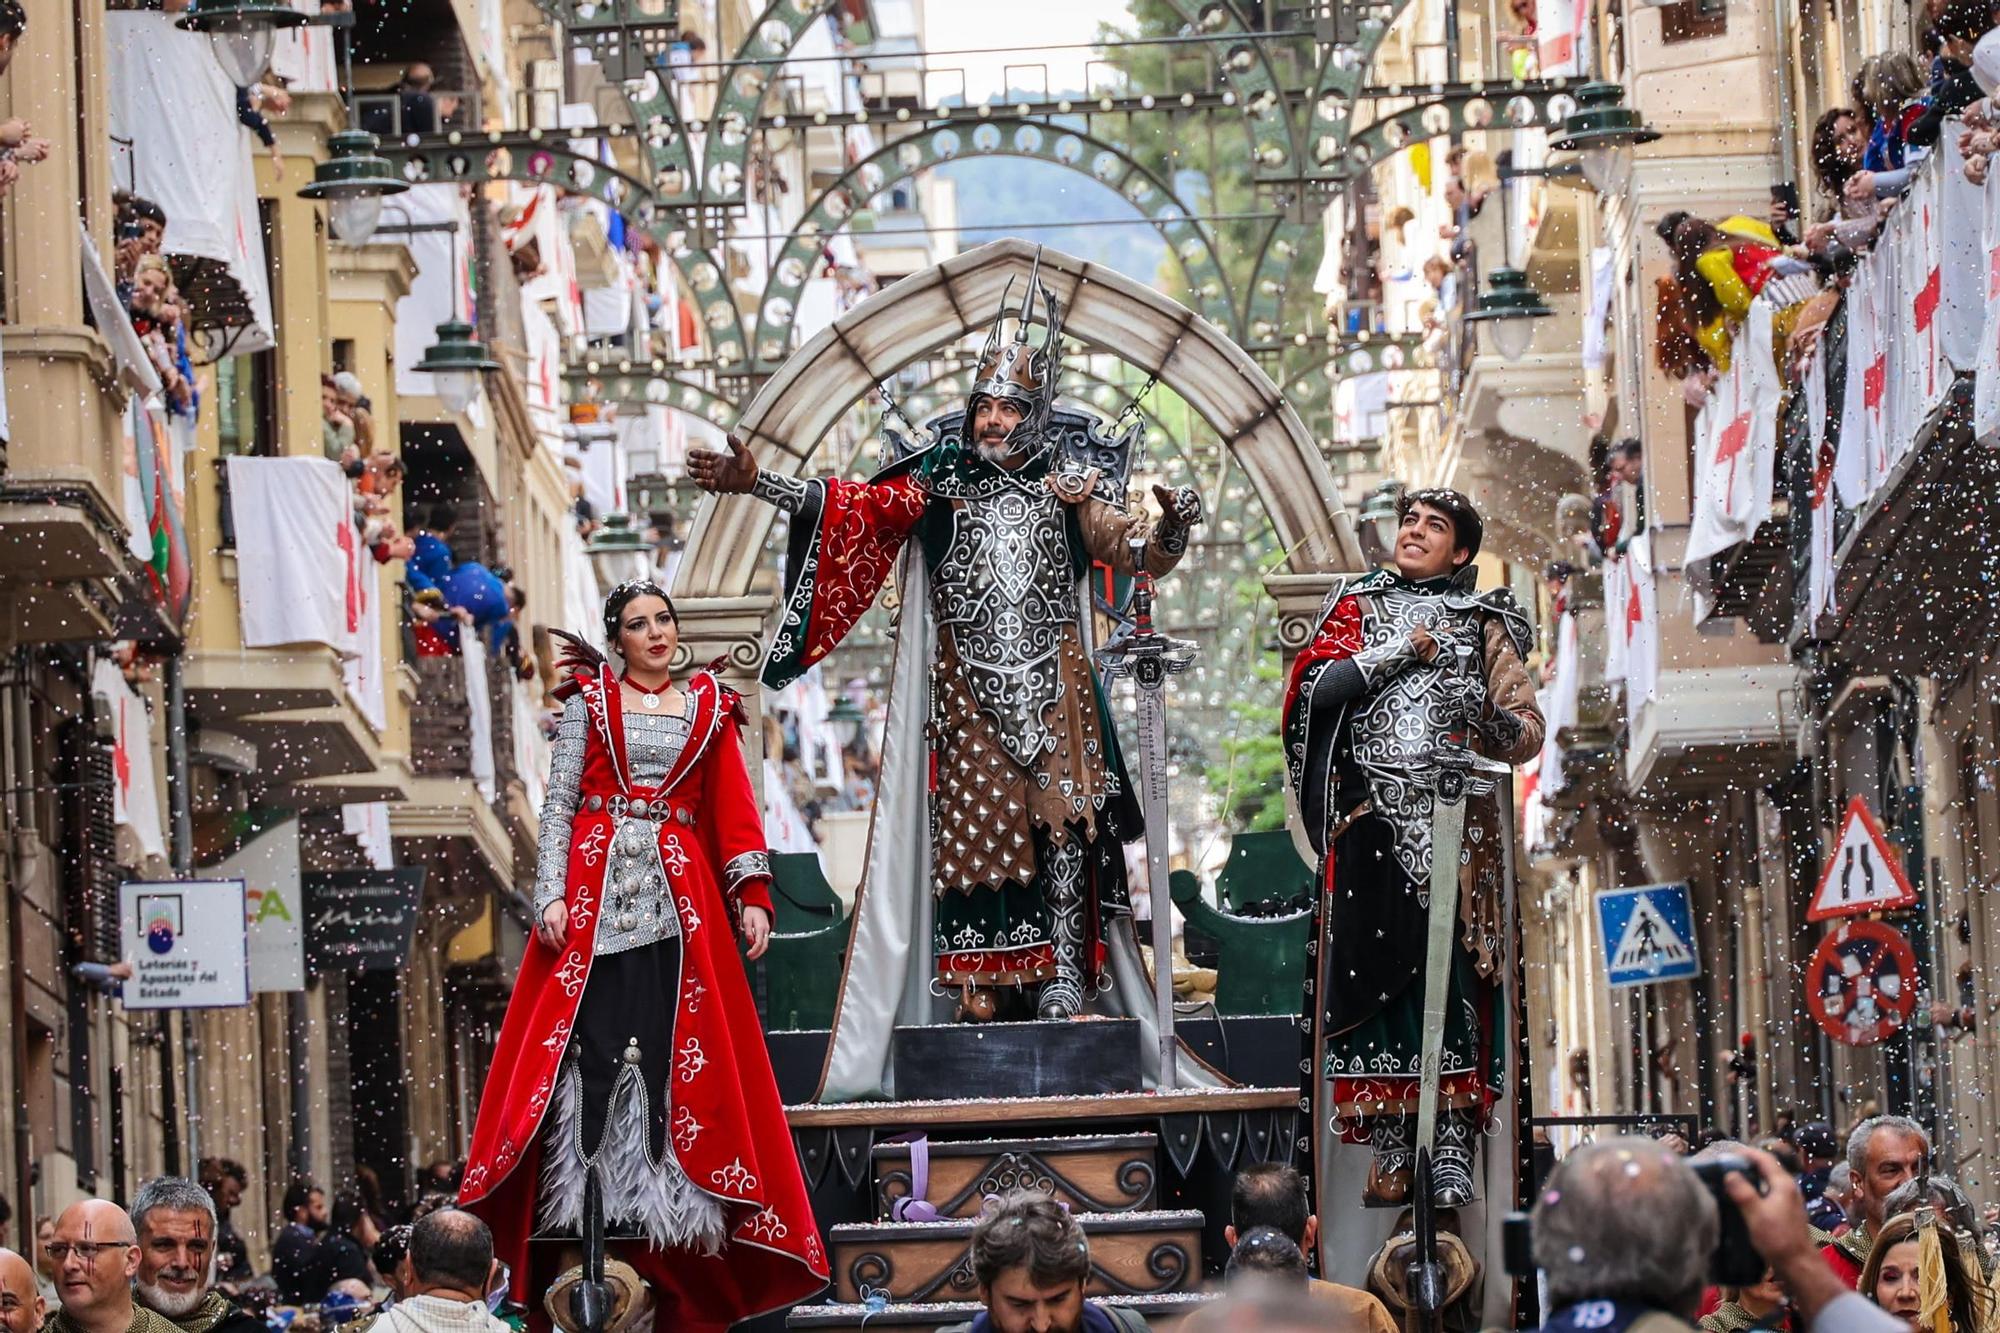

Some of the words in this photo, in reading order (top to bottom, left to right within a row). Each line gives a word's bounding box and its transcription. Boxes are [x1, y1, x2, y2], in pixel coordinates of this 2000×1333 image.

[140, 973, 195, 985] Apuestas
[200, 970, 218, 983] del
[140, 987, 181, 998] Estado
